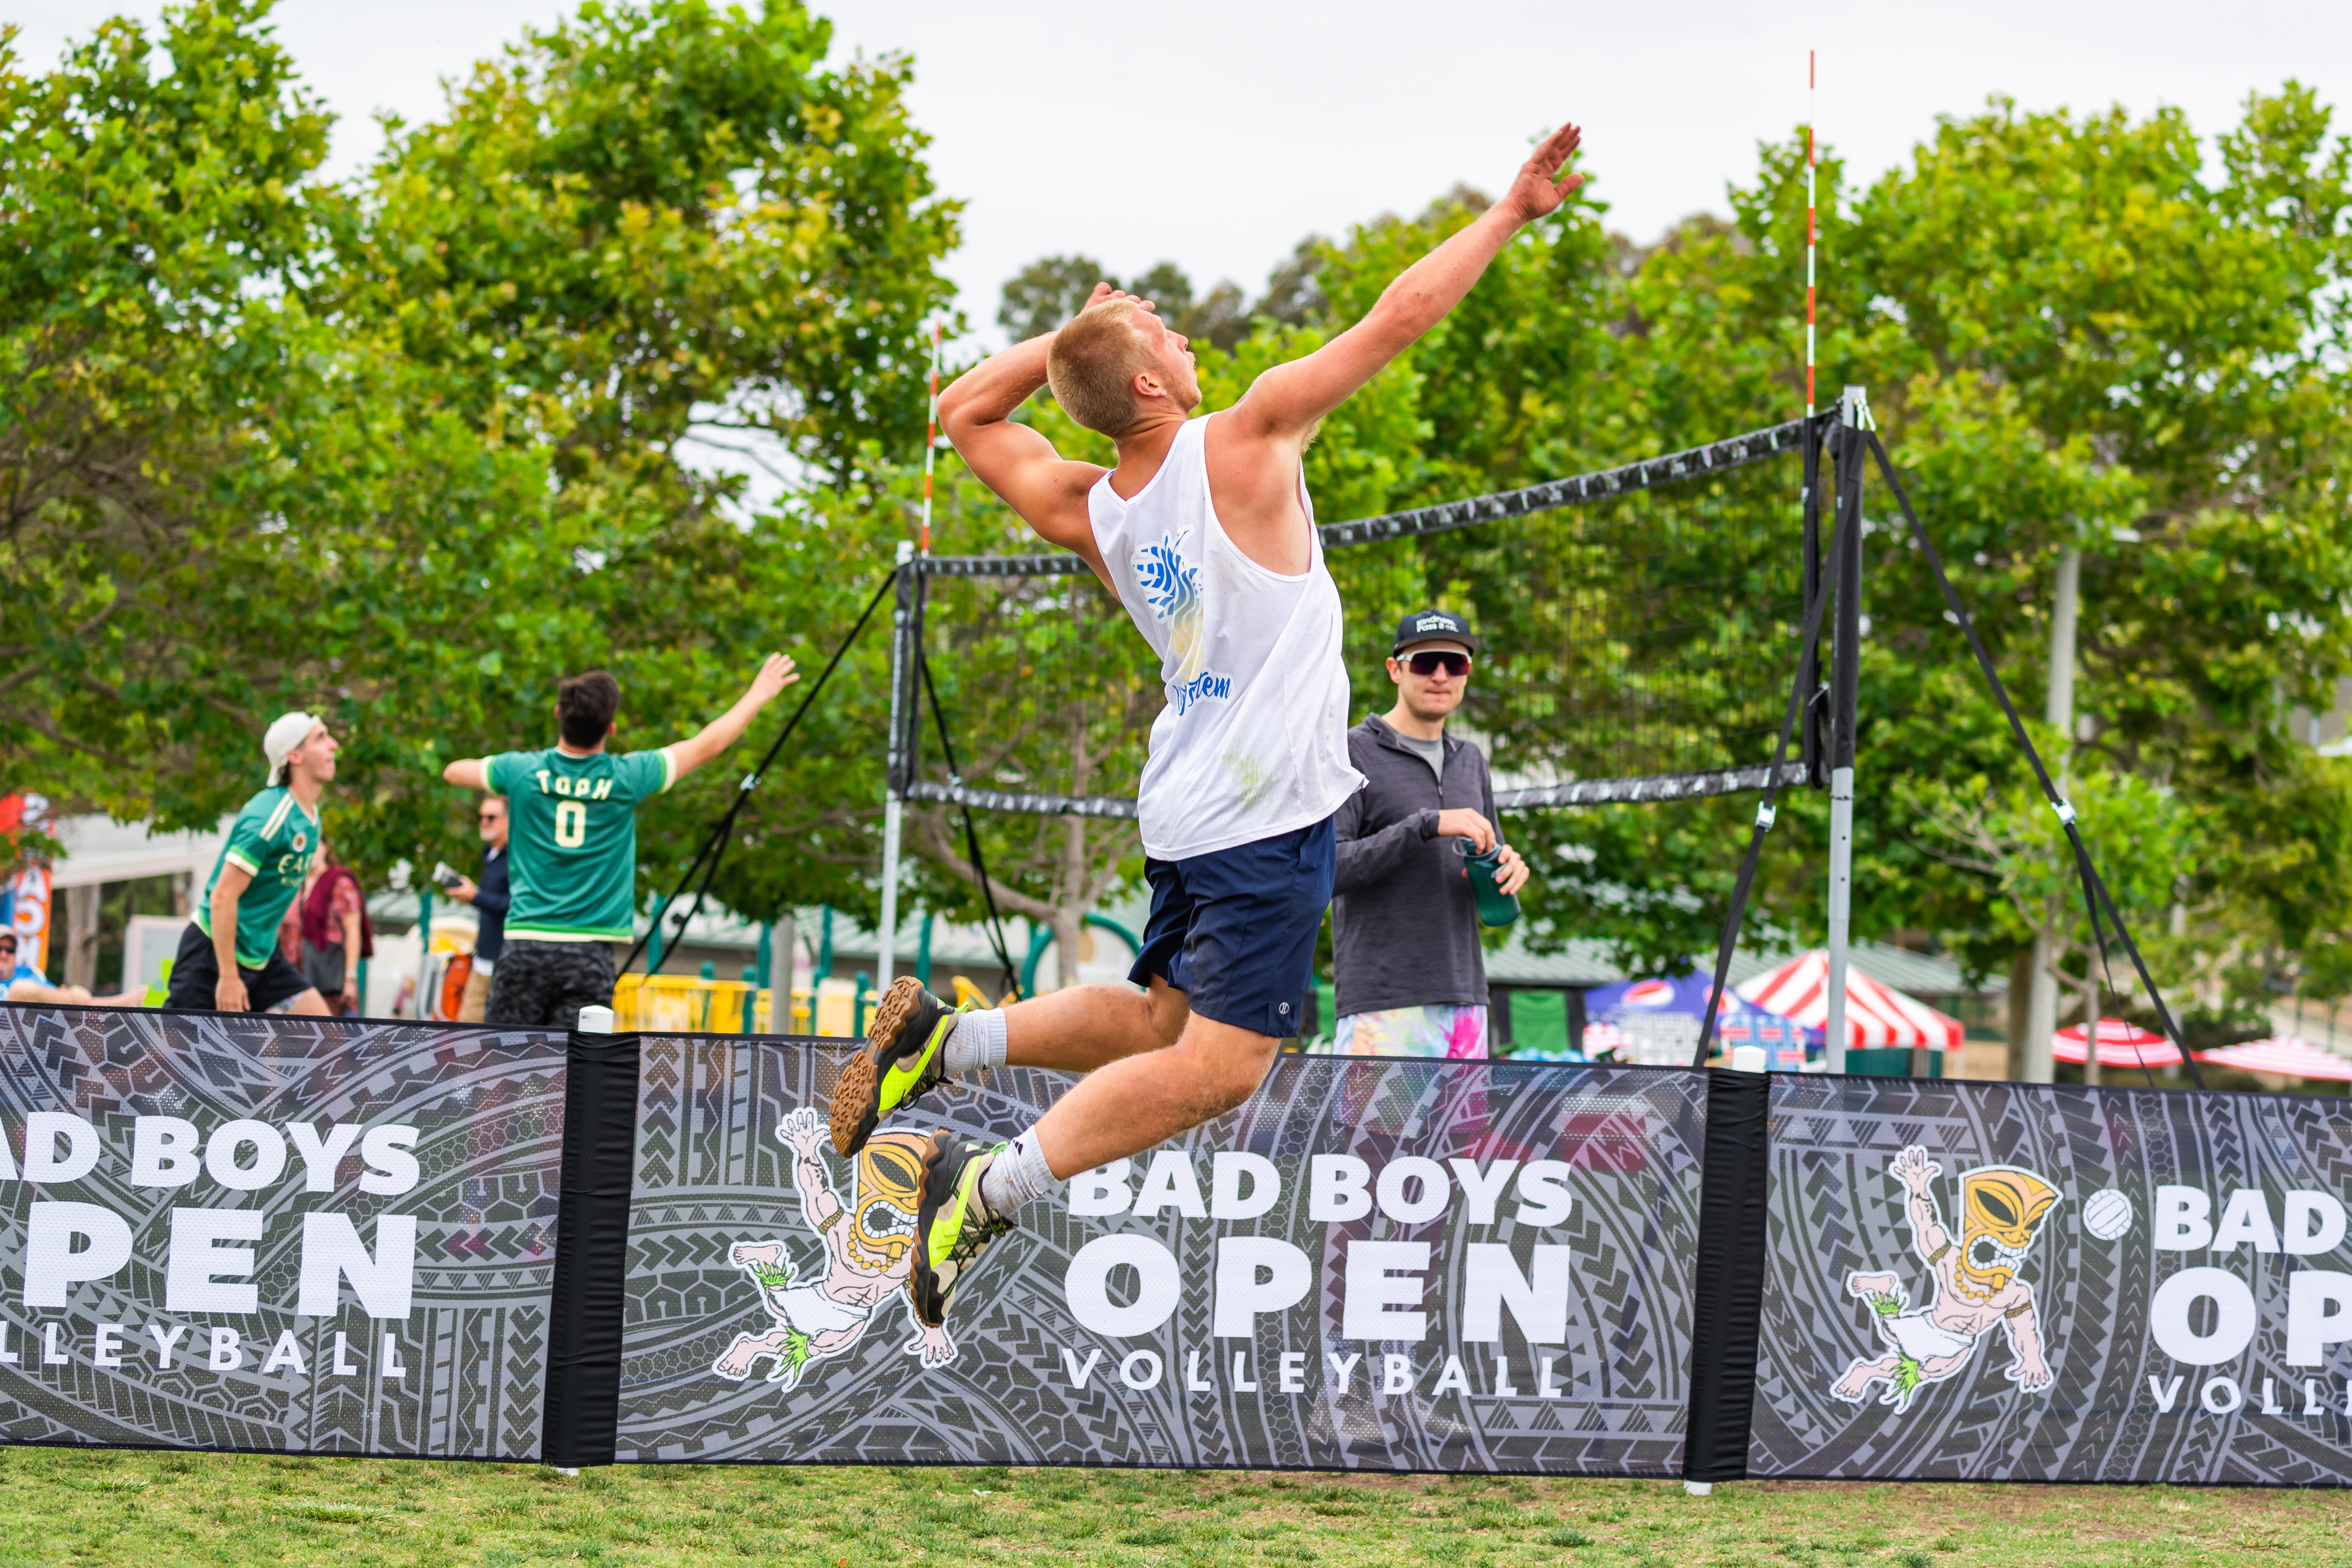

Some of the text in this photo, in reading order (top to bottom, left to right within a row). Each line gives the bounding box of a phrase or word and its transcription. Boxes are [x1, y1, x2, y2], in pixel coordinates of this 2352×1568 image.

[555, 800, 587, 848] 0
[0, 1112, 420, 1195] D BOYS
[1068, 1150, 1572, 1227] BAD BOYS
[2154, 1185, 2347, 1255] BAD
[1064, 1233, 1571, 1344] OPEN
[1062, 1348, 1562, 1399] VOLLEYBALL
